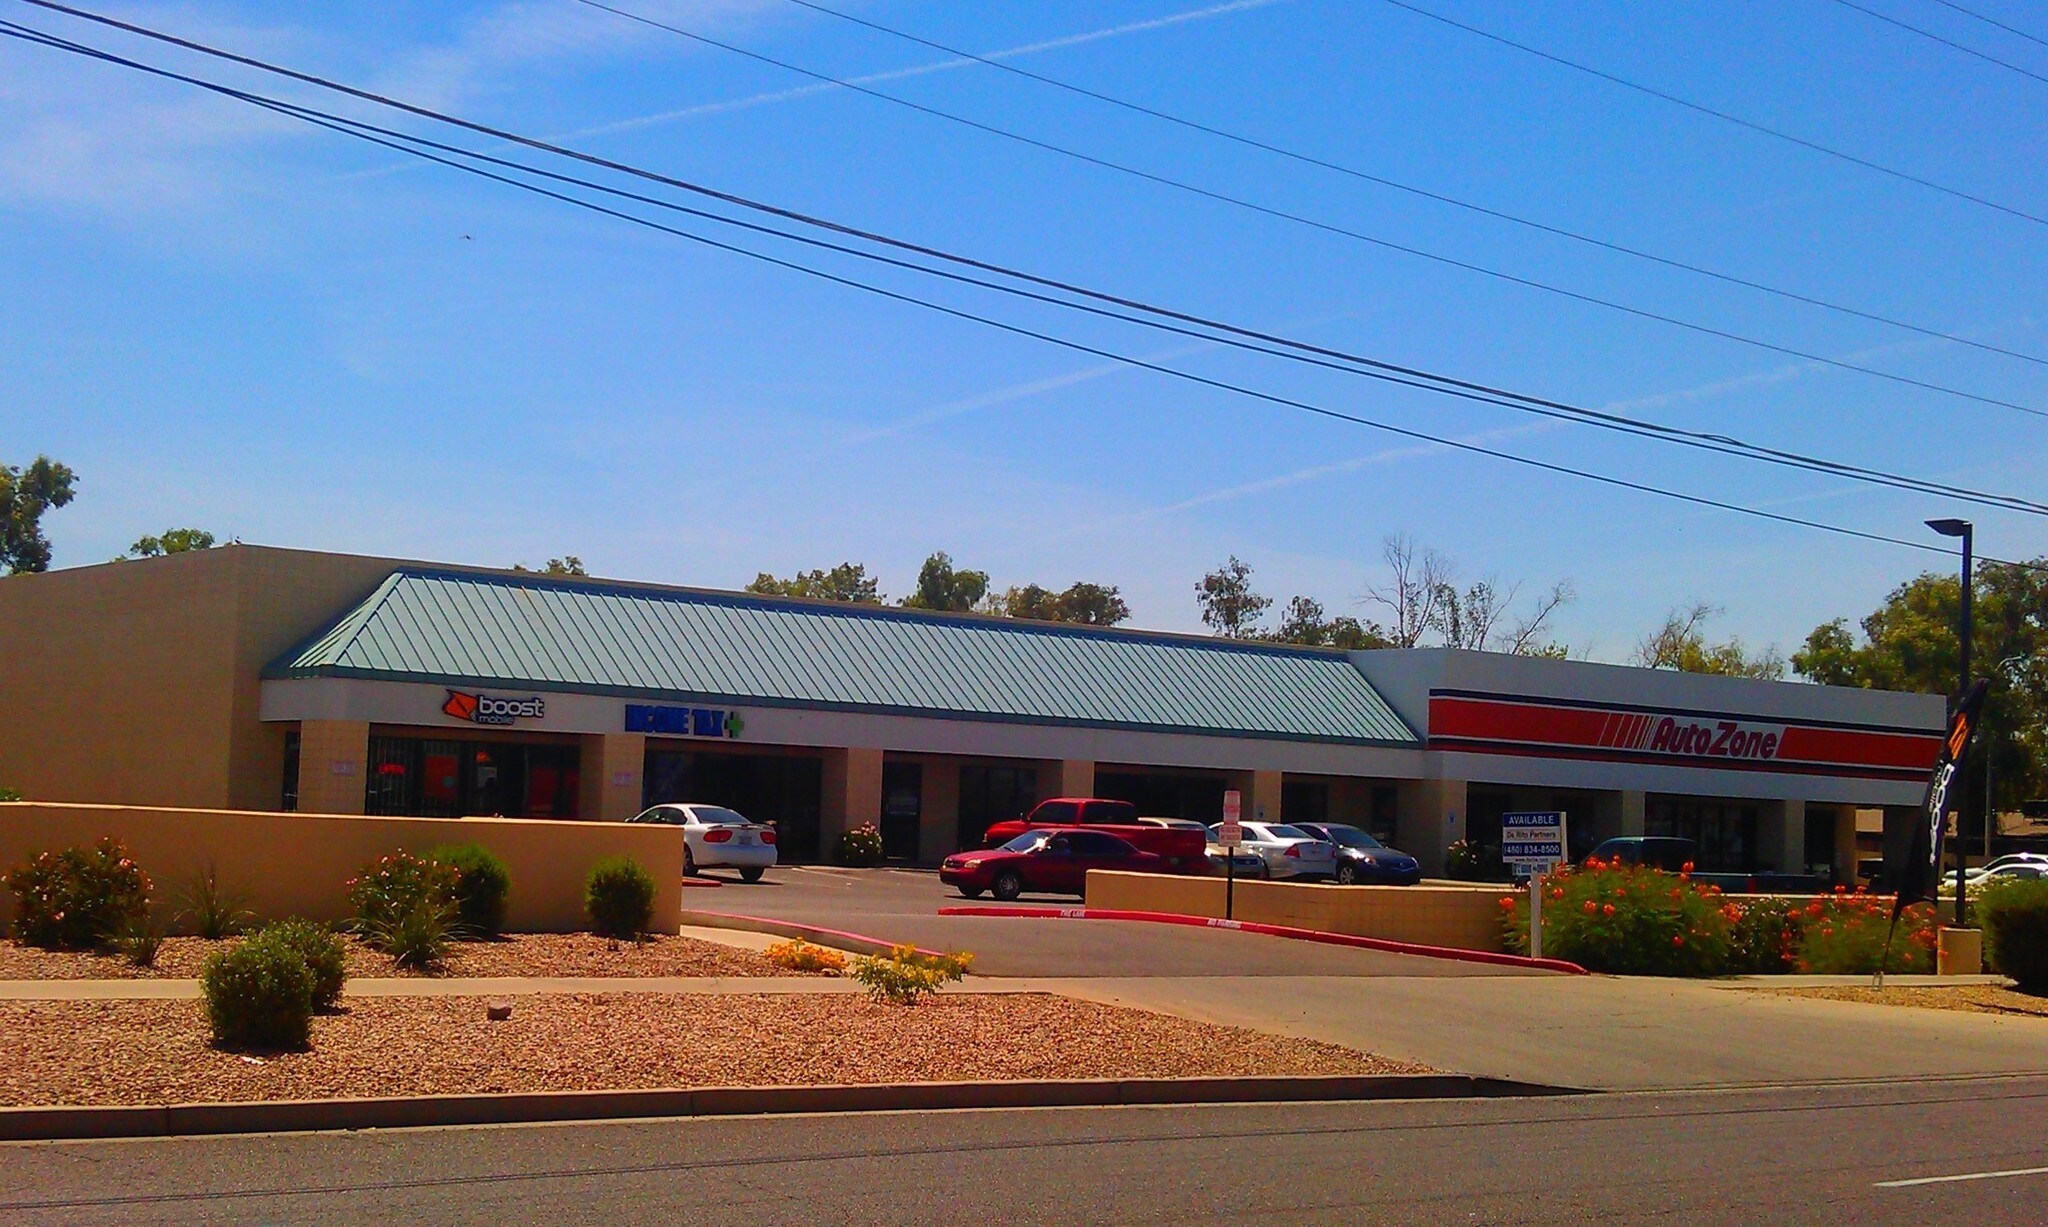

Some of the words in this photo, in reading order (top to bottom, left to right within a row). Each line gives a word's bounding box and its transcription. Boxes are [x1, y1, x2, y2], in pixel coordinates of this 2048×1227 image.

[479, 696, 544, 717] boost
[625, 704, 690, 734] INCOME
[692, 708, 725, 737] TAX
[1650, 716, 1777, 759] AutoZone
[1508, 815, 1555, 825] AVAILABLE
[1929, 762, 1955, 867] boost
